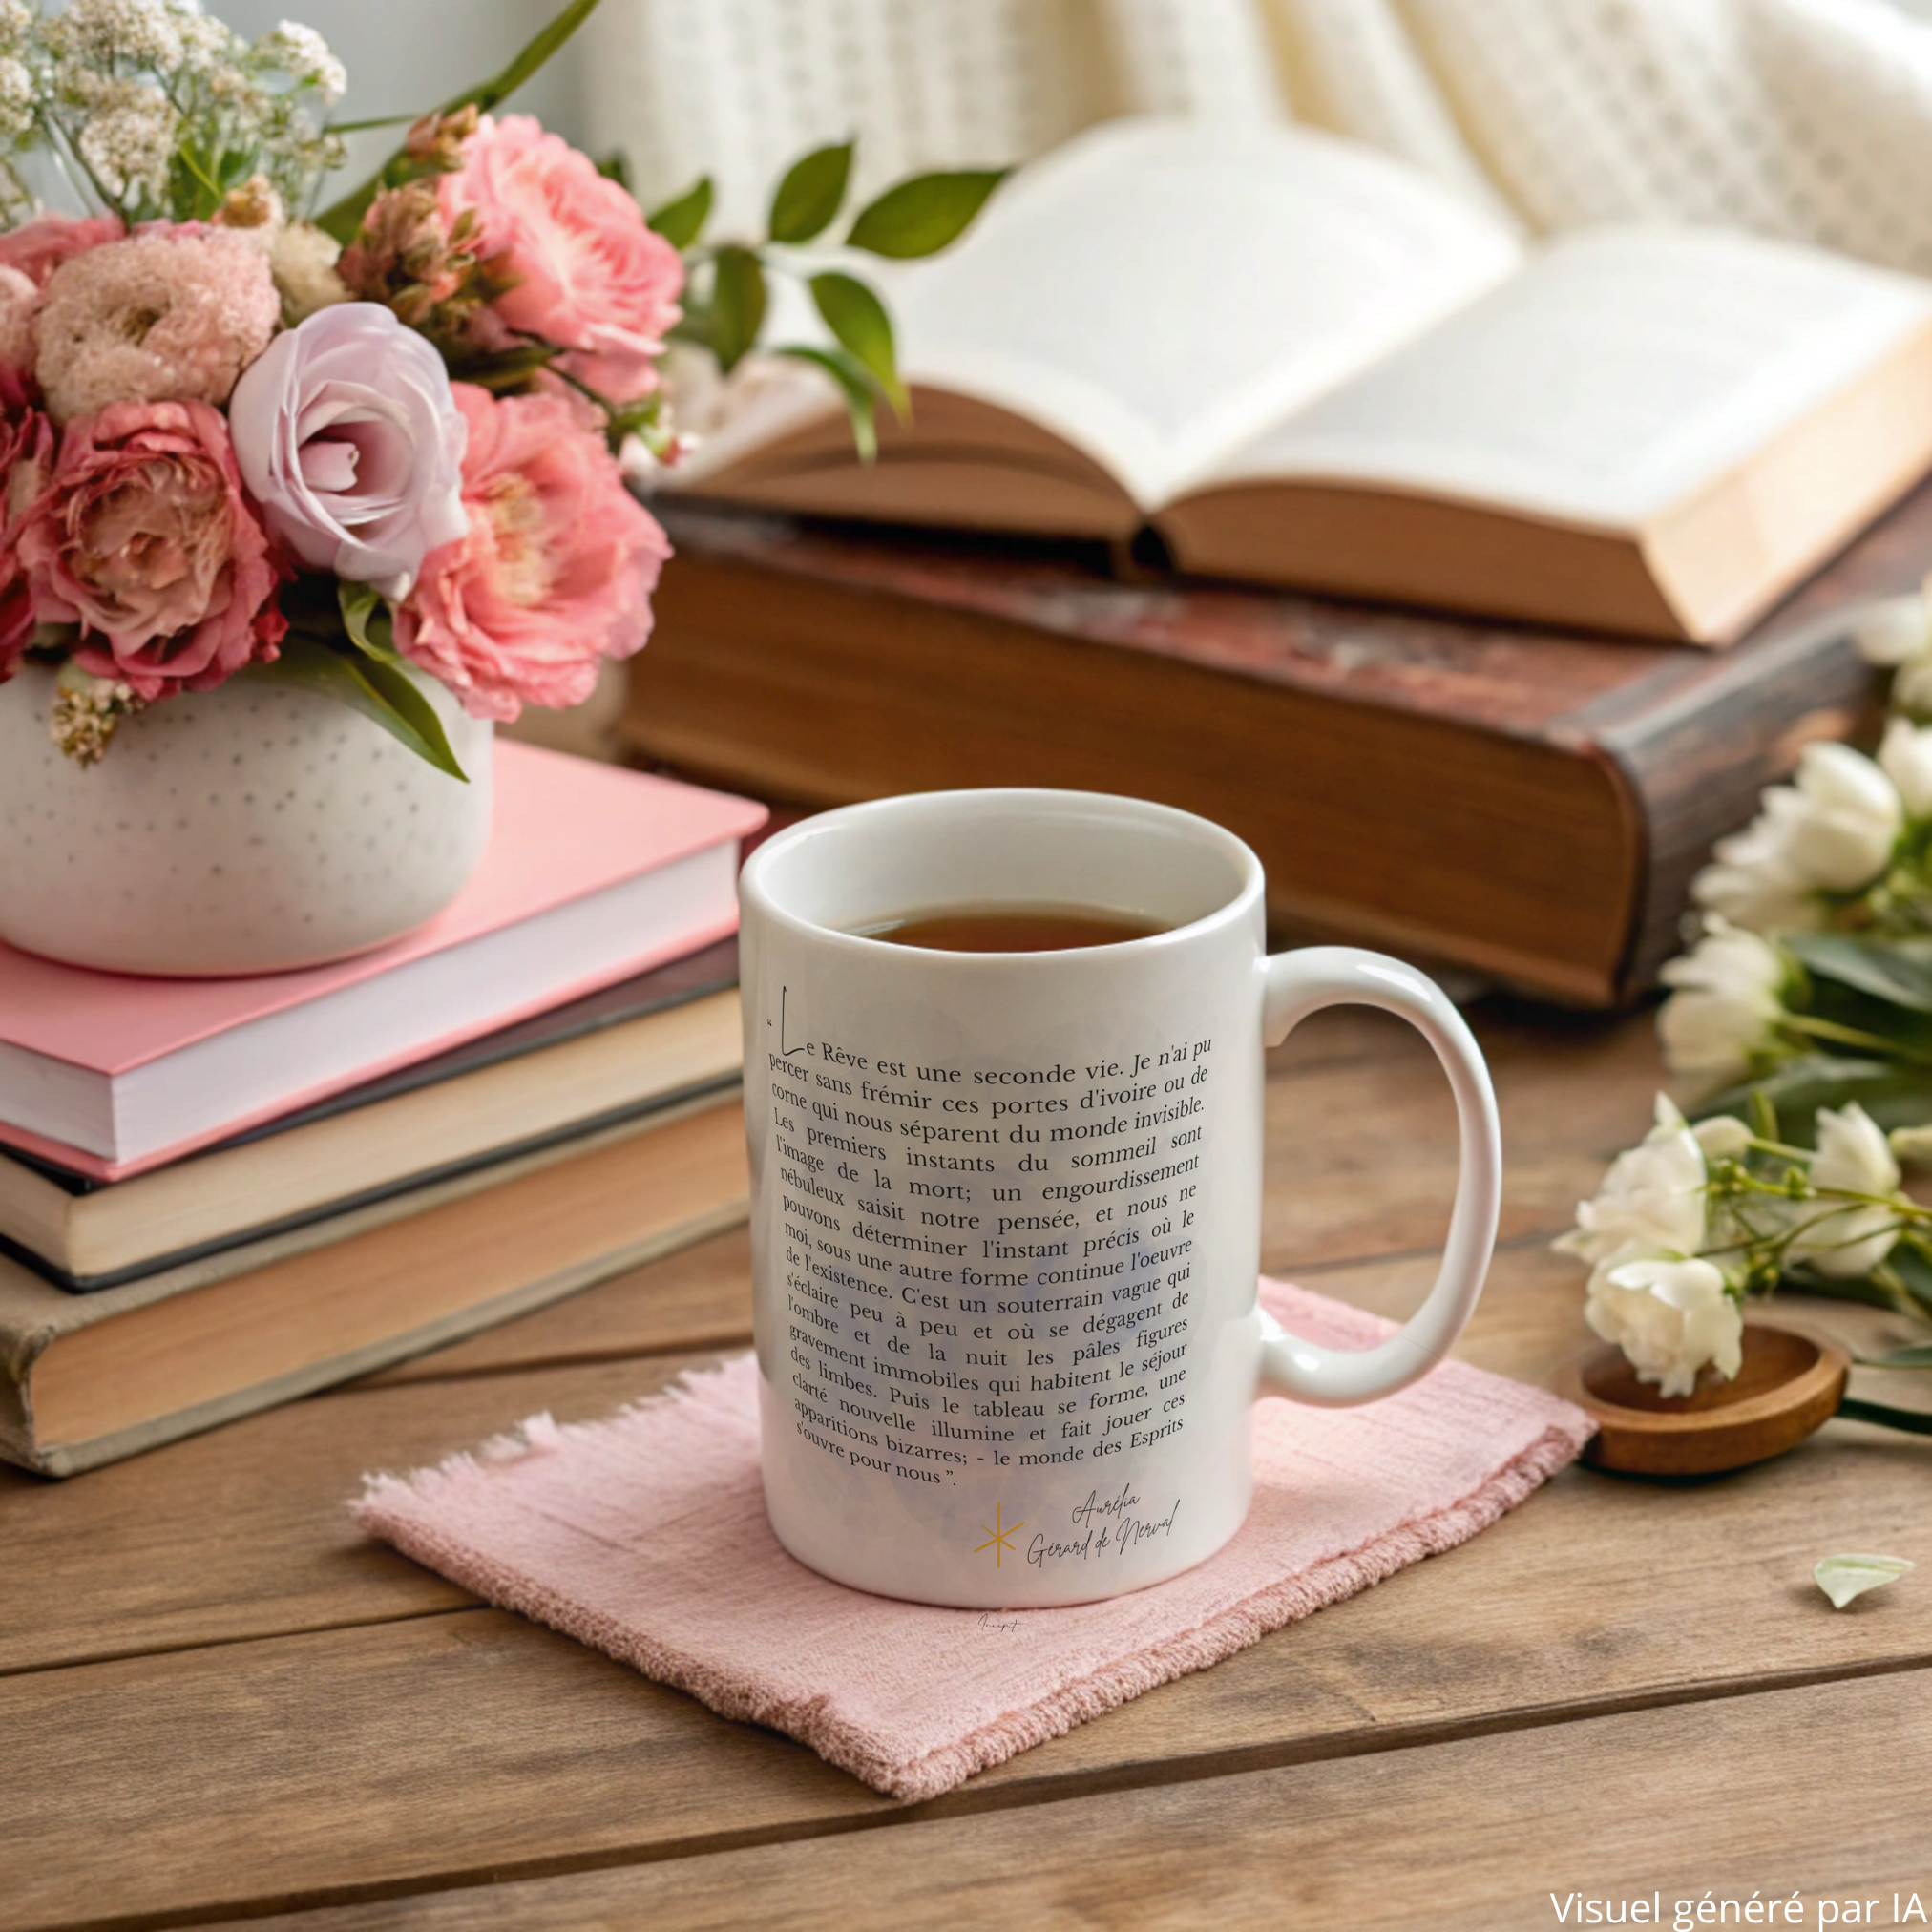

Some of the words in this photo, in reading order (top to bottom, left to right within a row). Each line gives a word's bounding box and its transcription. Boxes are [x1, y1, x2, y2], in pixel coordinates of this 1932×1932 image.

[768, 1053, 809, 1082] percer
[816, 1074, 852, 1095] sans
[861, 1081, 932, 1109] frémir
[942, 1100, 978, 1113] ces
[991, 1099, 1068, 1119] portes
[1080, 1082, 1157, 1109] d'ivoire
[1164, 1077, 1185, 1093] ou
[1191, 1065, 1208, 1085] de
[821, 1042, 868, 1070] Rêve
[877, 1061, 907, 1077] est
[916, 1067, 961, 1082] une
[974, 1064, 1076, 1084] seconde
[1085, 1060, 1124, 1079] vie.
[1129, 1054, 1150, 1078] Je
[1158, 1042, 1187, 1066] n'ai
[1191, 1039, 1212, 1062] pu
[772, 1083, 807, 1109] corne
[812, 1102, 839, 1121] qui
[845, 1111, 892, 1132] nous
[900, 1120, 1000, 1144] séparent
[1009, 1124, 1040, 1143] du
[1050, 1116, 1128, 1142] monde
[1134, 1096, 1204, 1130] invisible.
[774, 1107, 794, 1132] Les
[807, 1127, 886, 1160] premiers
[906, 1147, 995, 1172] instants
[1018, 1153, 1049, 1172] du
[1071, 1136, 1156, 1168] sommeil
[1171, 1125, 1202, 1148] sont
[776, 1134, 824, 1173] l'image
[837, 1162, 858, 1182] de
[874, 1169, 892, 1190] la
[909, 1182, 970, 1203] mort;
[992, 1188, 1021, 1201] un
[1042, 1155, 1199, 1203] engourdissement
[781, 1167, 845, 1206] nébuleux
[858, 1198, 905, 1221] saisit
[921, 1212, 979, 1229] notre
[998, 1209, 1079, 1235] pensée,
[1096, 1207, 1113, 1223] et
[1127, 1195, 1167, 1217] nous
[1179, 1185, 1197, 1202] ne
[783, 1195, 840, 1231] pouvons
[852, 1221, 967, 1256] déterminer
[983, 1240, 1068, 1258] l'instant
[1082, 1227, 1139, 1258] précis
[1151, 1217, 1171, 1237] où
[1182, 1209, 1194, 1228] le
[785, 1223, 812, 1250] moi,
[817, 1240, 851, 1261] sous
[857, 1253, 892, 1272] une
[899, 1264, 952, 1282] autre
[960, 1267, 1028, 1286] forme
[1037, 1262, 1124, 1285] continue
[1131, 1240, 1192, 1270] l'oeuvre
[787, 1246, 800, 1266] de
[805, 1254, 892, 1299] l'existence.
[902, 1287, 949, 1309] C'est
[959, 1299, 986, 1312] un
[998, 1290, 1102, 1313] souterrain
[1111, 1278, 1161, 1301] vague
[1167, 1262, 1190, 1289] qui
[788, 1272, 838, 1309] s'éclaire
[850, 1303, 883, 1322] peu
[896, 1312, 906, 1328] à
[919, 1321, 957, 1336] peu
[974, 1326, 993, 1339] et
[1008, 1323, 1034, 1340] où
[1050, 1325, 1069, 1337] se
[1083, 1303, 1162, 1334] dégagent
[1172, 1291, 1189, 1309] de
[788, 1294, 838, 1334] l'ombre
[854, 1331, 871, 1345] et
[888, 1335, 910, 1354] de
[929, 1343, 946, 1361] la
[966, 1350, 1007, 1366] nuit
[1027, 1349, 1054, 1365] les
[1072, 1340, 1120, 1366] pâles
[1136, 1318, 1187, 1348] figures
[790, 1325, 866, 1369] gravement
[873, 1356, 978, 1390] immobiles
[989, 1376, 1020, 1396] qui
[1030, 1369, 1111, 1391] habitent
[1119, 1361, 1134, 1377] le
[1142, 1343, 1187, 1372] séjour
[791, 1346, 810, 1370] des
[818, 1360, 877, 1397] limbes.
[890, 1387, 930, 1410] Puis
[942, 1396, 959, 1414] le
[974, 1400, 1044, 1417] tableau
[1058, 1401, 1077, 1414] se
[1089, 1386, 1148, 1409] forme,
[1160, 1369, 1186, 1390] une
[792, 1373, 828, 1403] clarté
[839, 1399, 915, 1431] nouvelle
[932, 1420, 1014, 1441] illumine
[1030, 1428, 1046, 1440] et
[1061, 1420, 1091, 1438] fait
[1102, 1408, 1152, 1436] jouer
[1163, 1394, 1185, 1413] ces
[795, 1398, 878, 1446] apparitions
[885, 1435, 967, 1465] bizarres;
[994, 1450, 1010, 1465] le
[1019, 1446, 1084, 1465] monde
[1093, 1440, 1122, 1457] des
[1129, 1418, 1183, 1448] Esprits
[797, 1421, 845, 1458] s'ouvre
[849, 1451, 892, 1472] pour
[896, 1465, 940, 1483] nous
[1027, 1530, 1093, 1568] Gérard
[1095, 1526, 1111, 1557] de
[1115, 1499, 1181, 1555] Nerval
[1072, 1482, 1141, 1528] Aurélia
